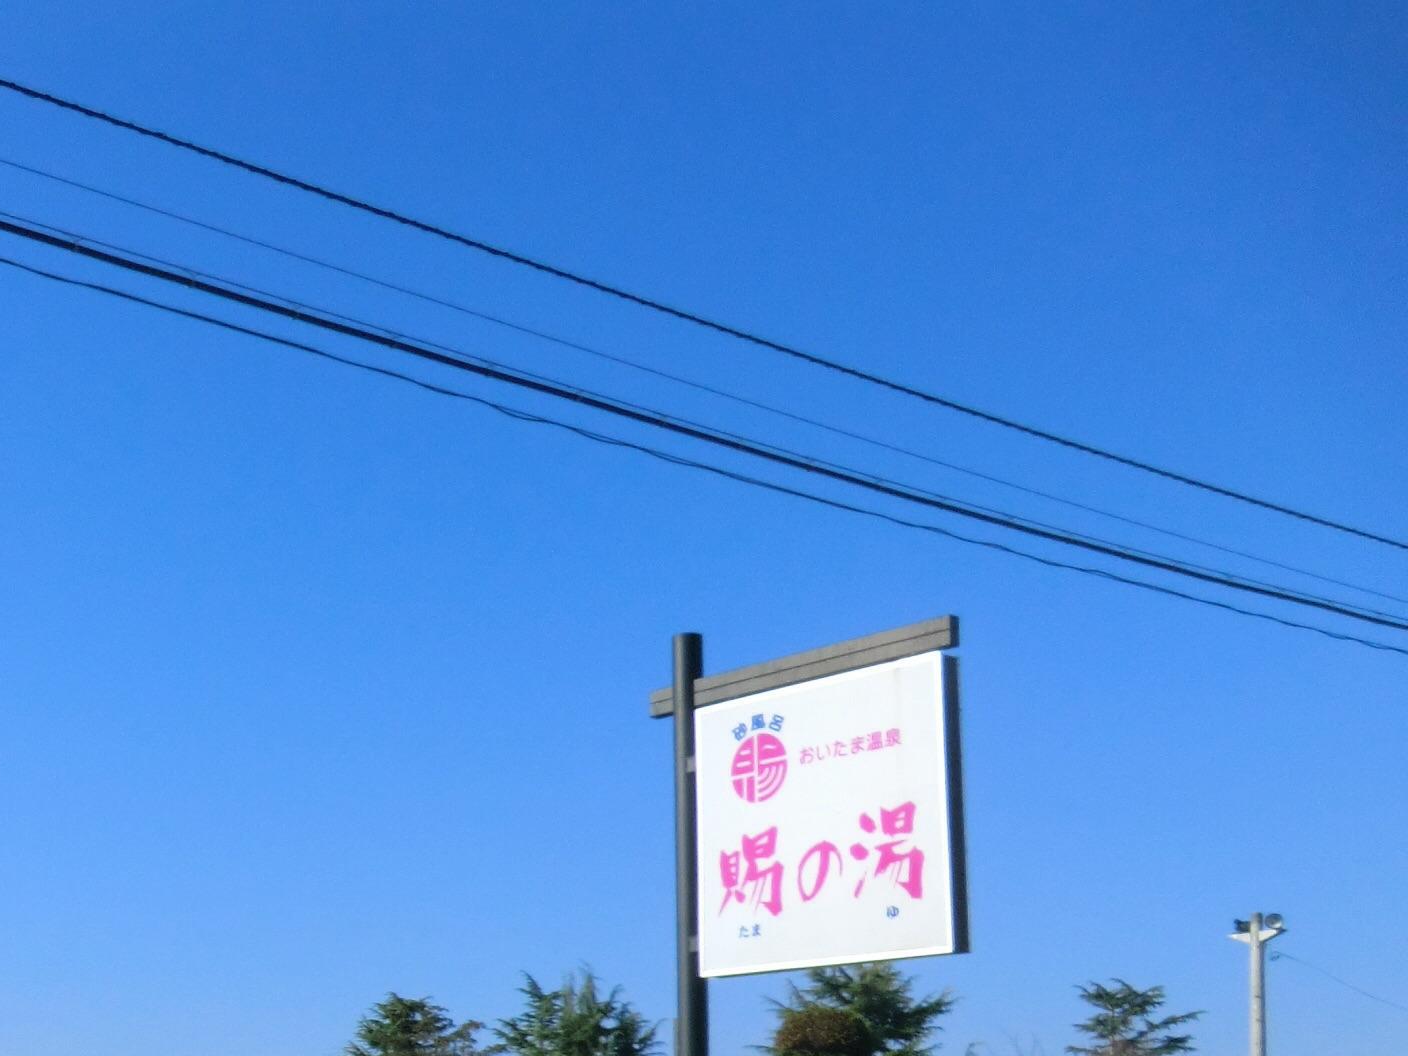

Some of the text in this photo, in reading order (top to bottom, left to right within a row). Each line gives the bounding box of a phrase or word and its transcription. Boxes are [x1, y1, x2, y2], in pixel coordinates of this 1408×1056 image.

[731, 713, 785, 741] 砂風呂
[799, 727, 902, 765] おいたま温泉
[718, 800, 925, 917] 賜の湯
[886, 905, 900, 919] ゆ
[738, 925, 762, 939] たま
